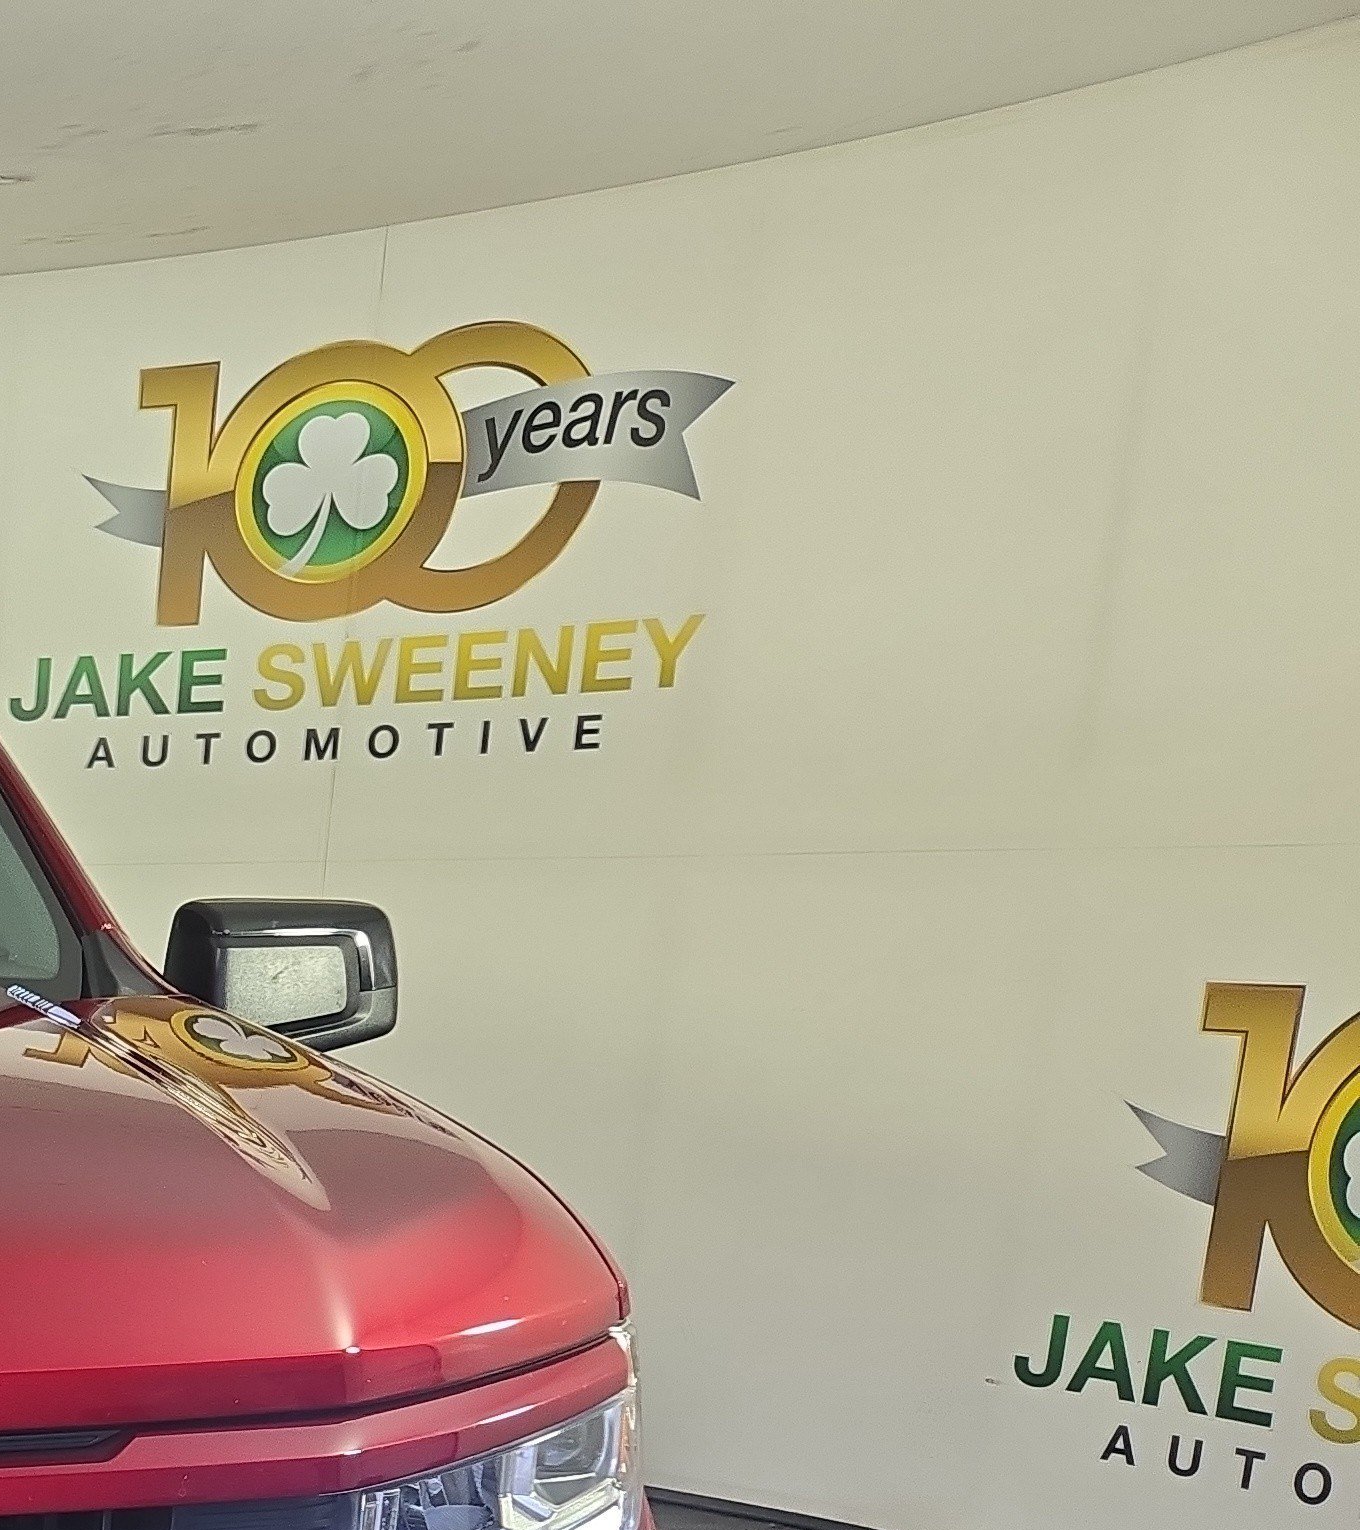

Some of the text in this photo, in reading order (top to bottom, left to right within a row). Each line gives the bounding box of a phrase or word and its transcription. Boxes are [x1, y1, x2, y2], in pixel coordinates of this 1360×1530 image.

[140, 320, 672, 626] 100 years
[9, 613, 707, 722] JAKE SWEENEY
[86, 714, 604, 769] AUTOMOTIVE
[1013, 1314, 1284, 1428] JAKE
